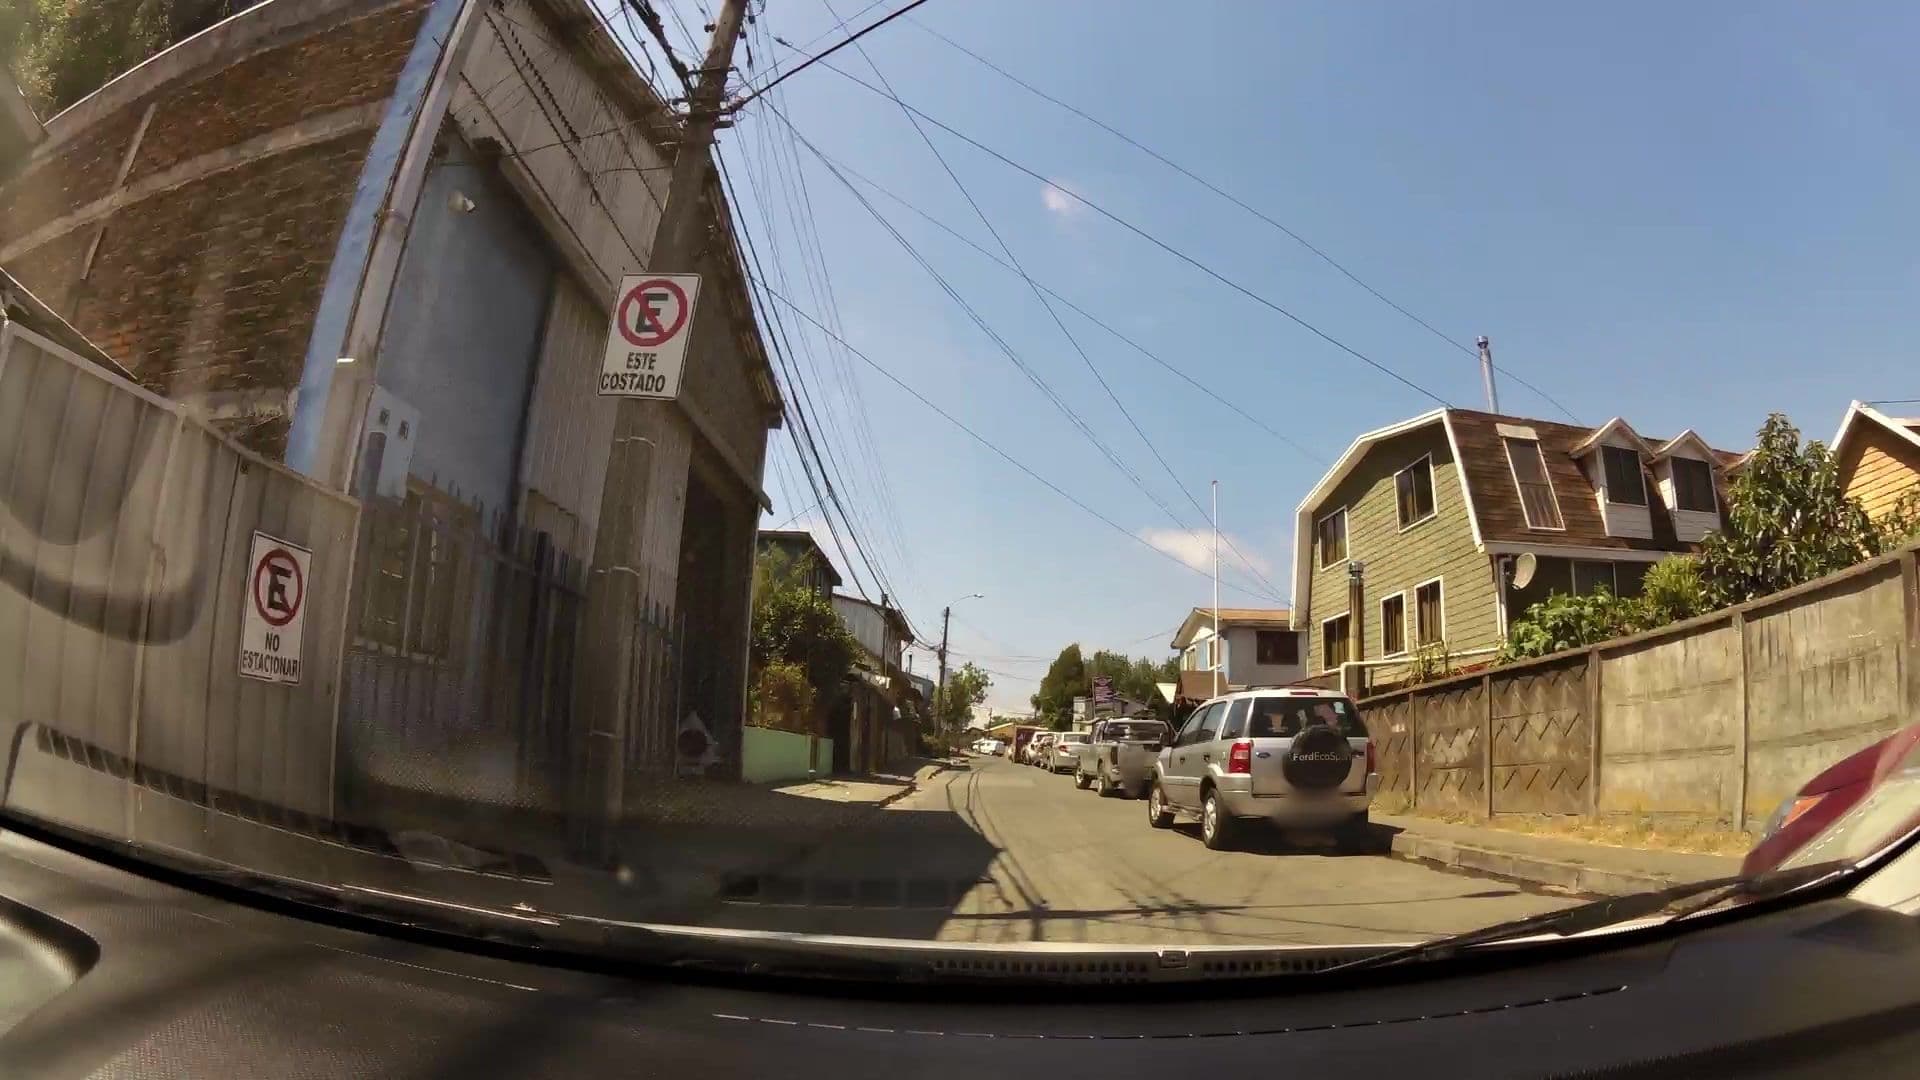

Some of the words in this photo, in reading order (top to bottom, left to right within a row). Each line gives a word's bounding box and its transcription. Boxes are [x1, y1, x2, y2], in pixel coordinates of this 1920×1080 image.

[626, 352, 657, 370] ESTE
[601, 372, 666, 392] COSTADO
[265, 632, 280, 652] NO
[242, 650, 299, 677] ESTACIONAR
